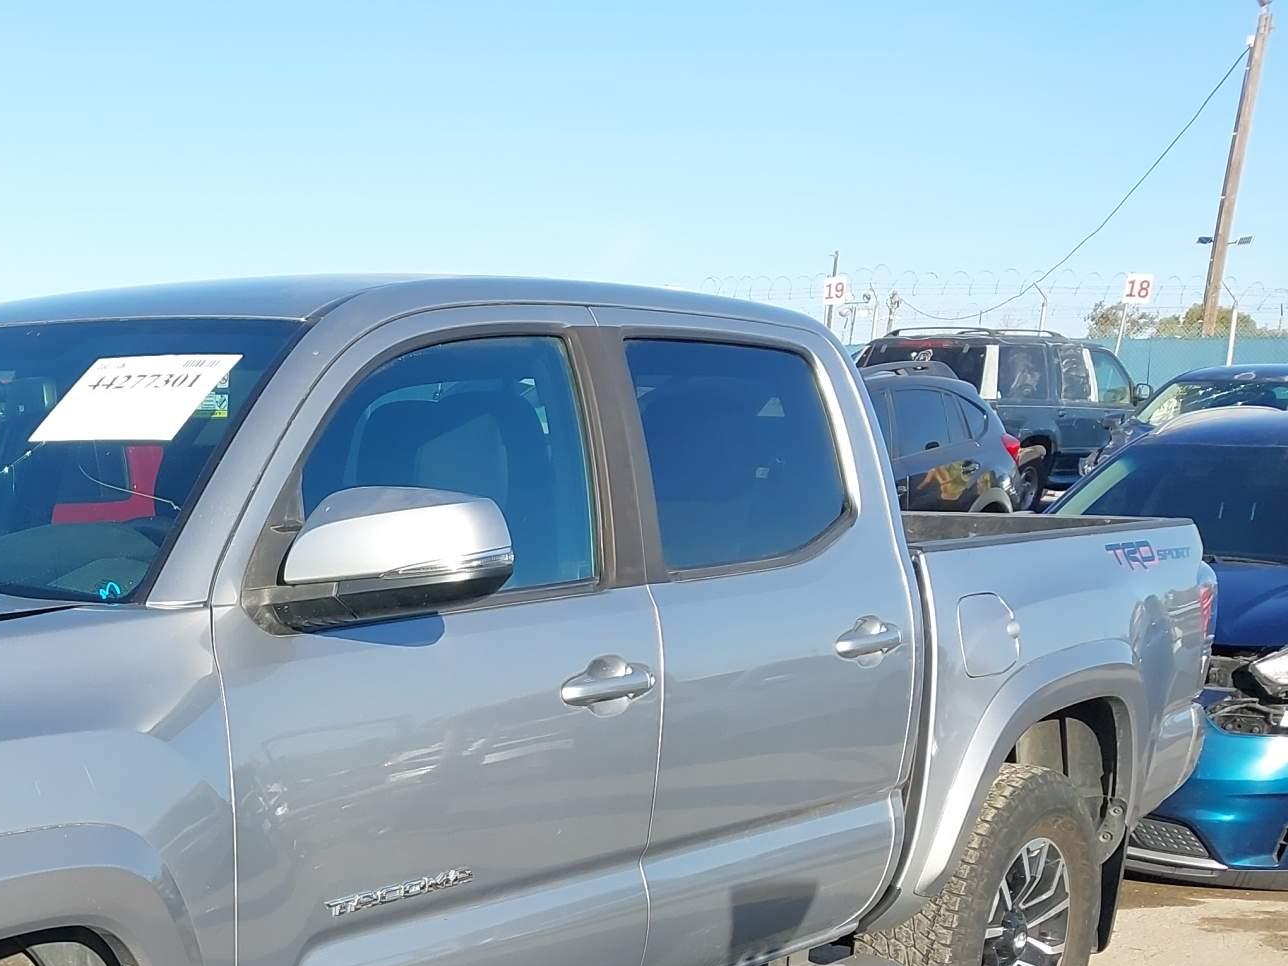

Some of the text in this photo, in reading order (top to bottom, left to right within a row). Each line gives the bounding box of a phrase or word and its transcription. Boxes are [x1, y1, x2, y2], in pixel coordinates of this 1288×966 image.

[824, 282, 845, 300] 19
[1125, 279, 1150, 299] 18
[87, 372, 202, 391] 44277301
[1104, 539, 1191, 571] TRD SPORT
[323, 865, 473, 917] TACOMA
